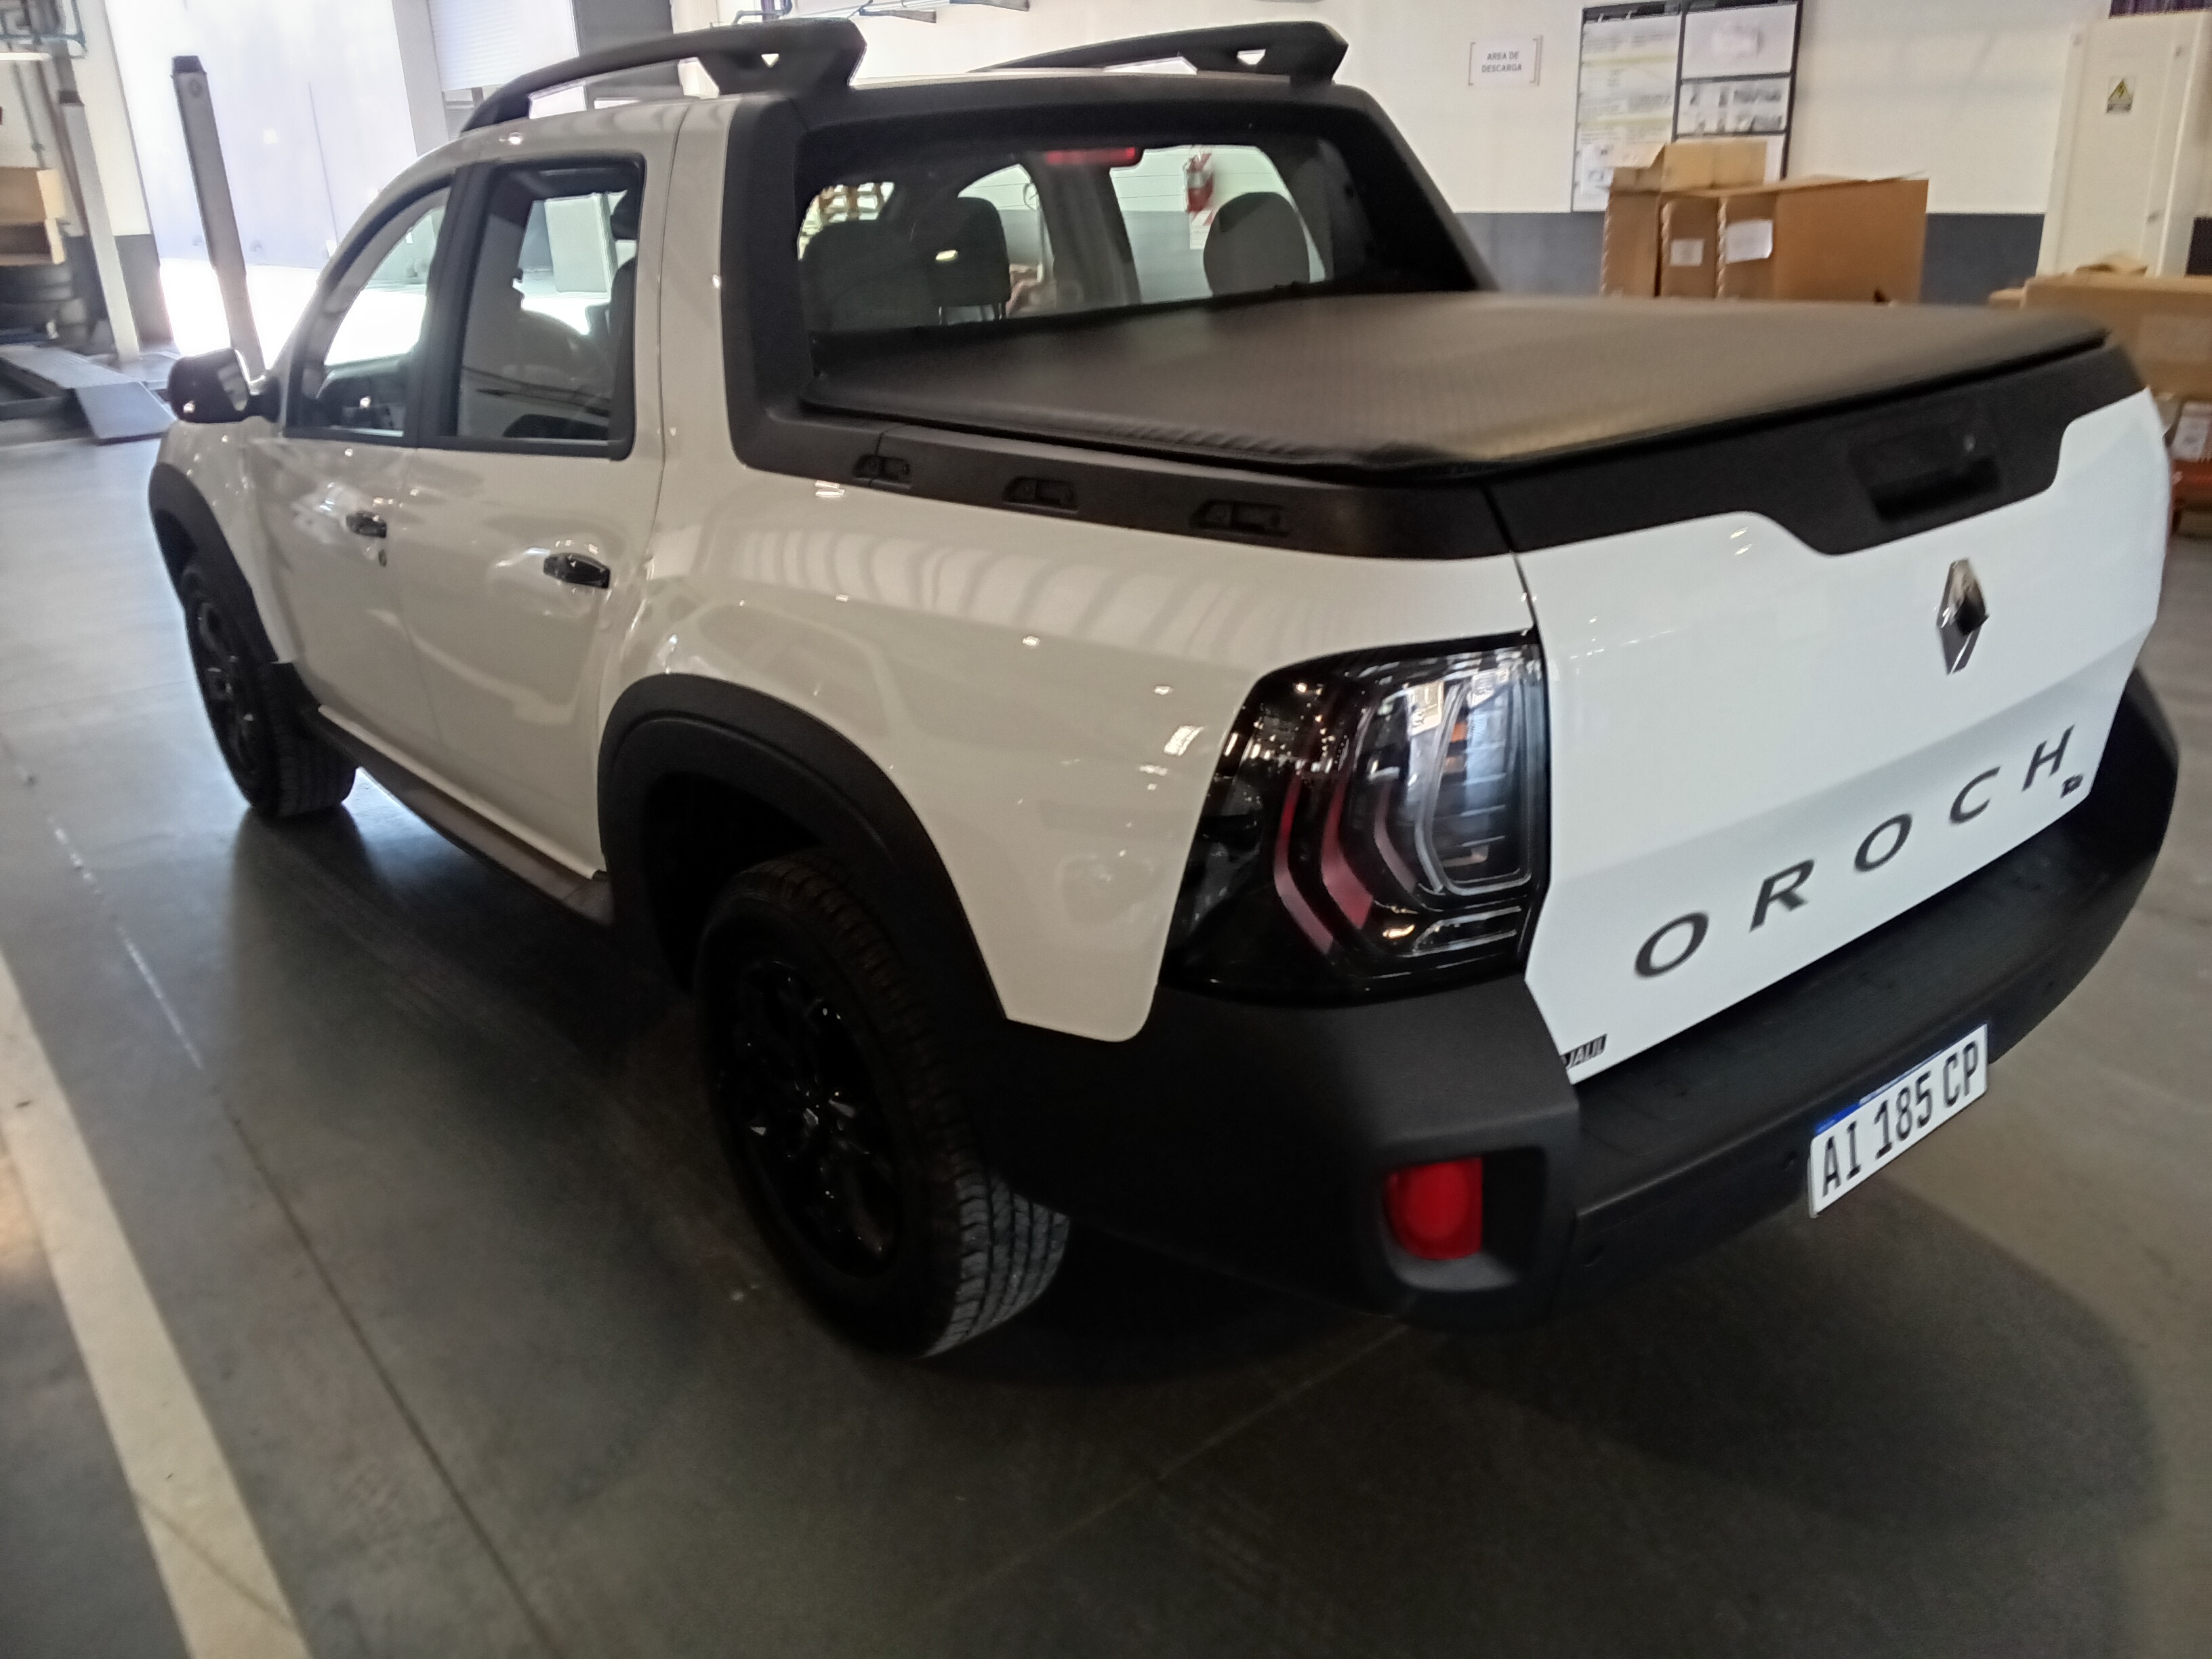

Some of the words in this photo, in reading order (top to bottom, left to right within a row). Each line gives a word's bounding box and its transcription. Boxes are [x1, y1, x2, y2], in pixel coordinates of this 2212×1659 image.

[1481, 64, 1522, 73] DESCARGA
[1486, 52, 1507, 60] AREA
[1509, 51, 1519, 60] DE
[1634, 724, 2075, 979] OROCH
[1822, 1120, 1861, 1197] AI
[1874, 1070, 1932, 1160] 185
[1942, 1040, 1978, 1108] CP
